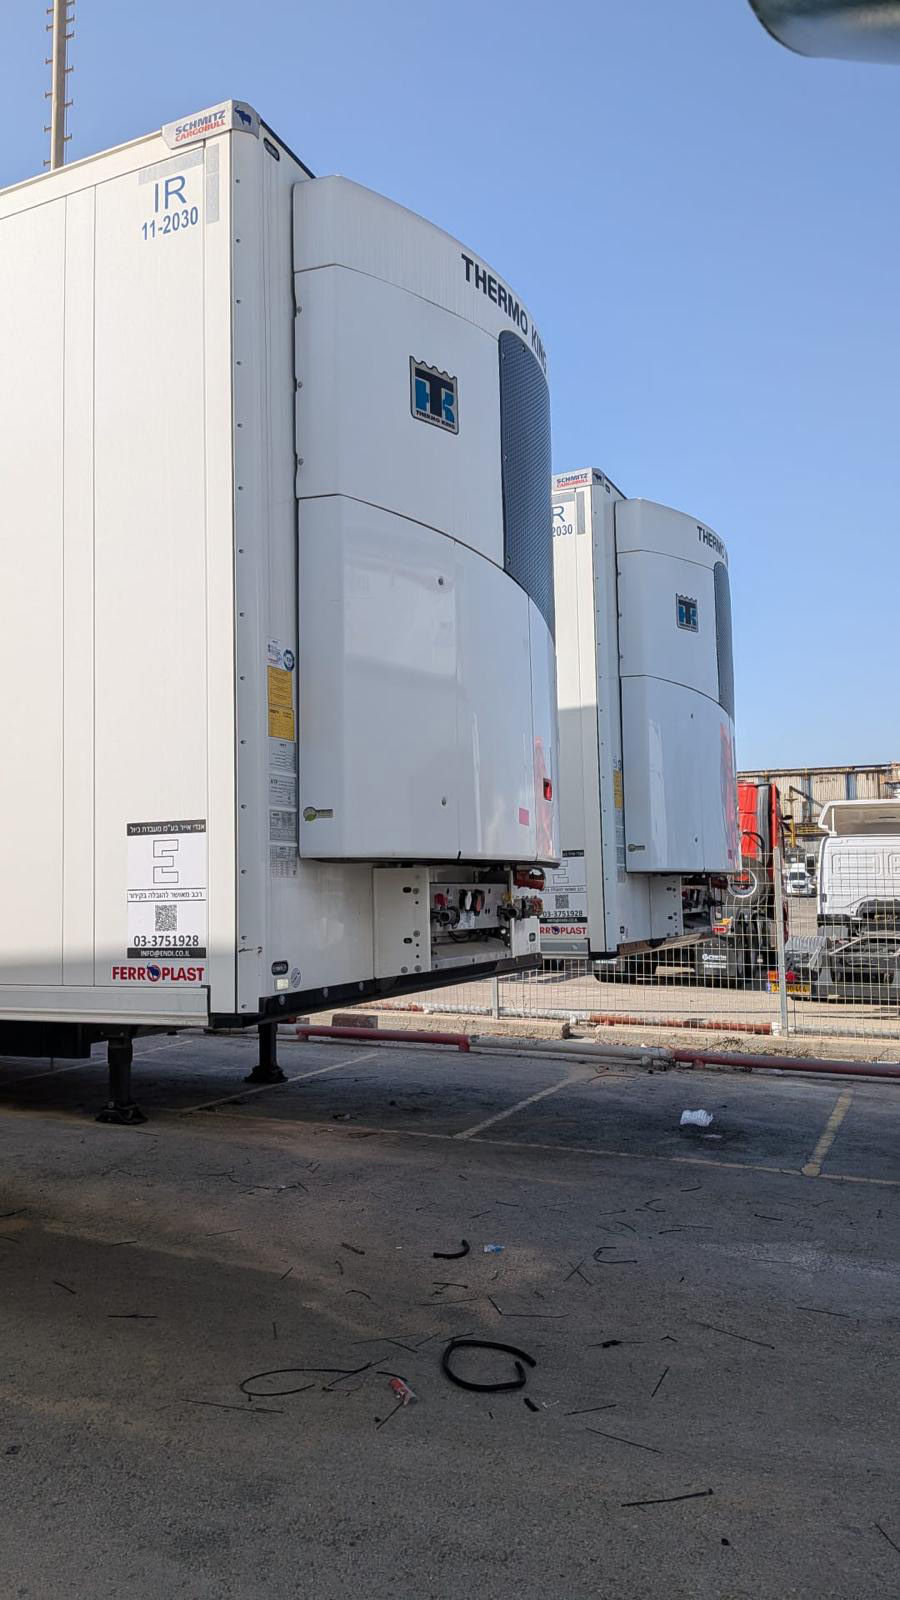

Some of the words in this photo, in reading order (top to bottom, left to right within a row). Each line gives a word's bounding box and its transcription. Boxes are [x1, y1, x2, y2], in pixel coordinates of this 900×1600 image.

[175, 109, 225, 136] SCHMITZ
[175, 119, 225, 142] CARGOBULL
[154, 175, 187, 213] IR
[141, 206, 199, 240] 11-2030
[461, 253, 528, 336] THERMO
[551, 505, 565, 522] R
[133, 935, 199, 947] 03-3751928
[140, 949, 191, 958] INFO@ENDI.CO.IL
[111, 964, 205, 982] FERROPLAST
